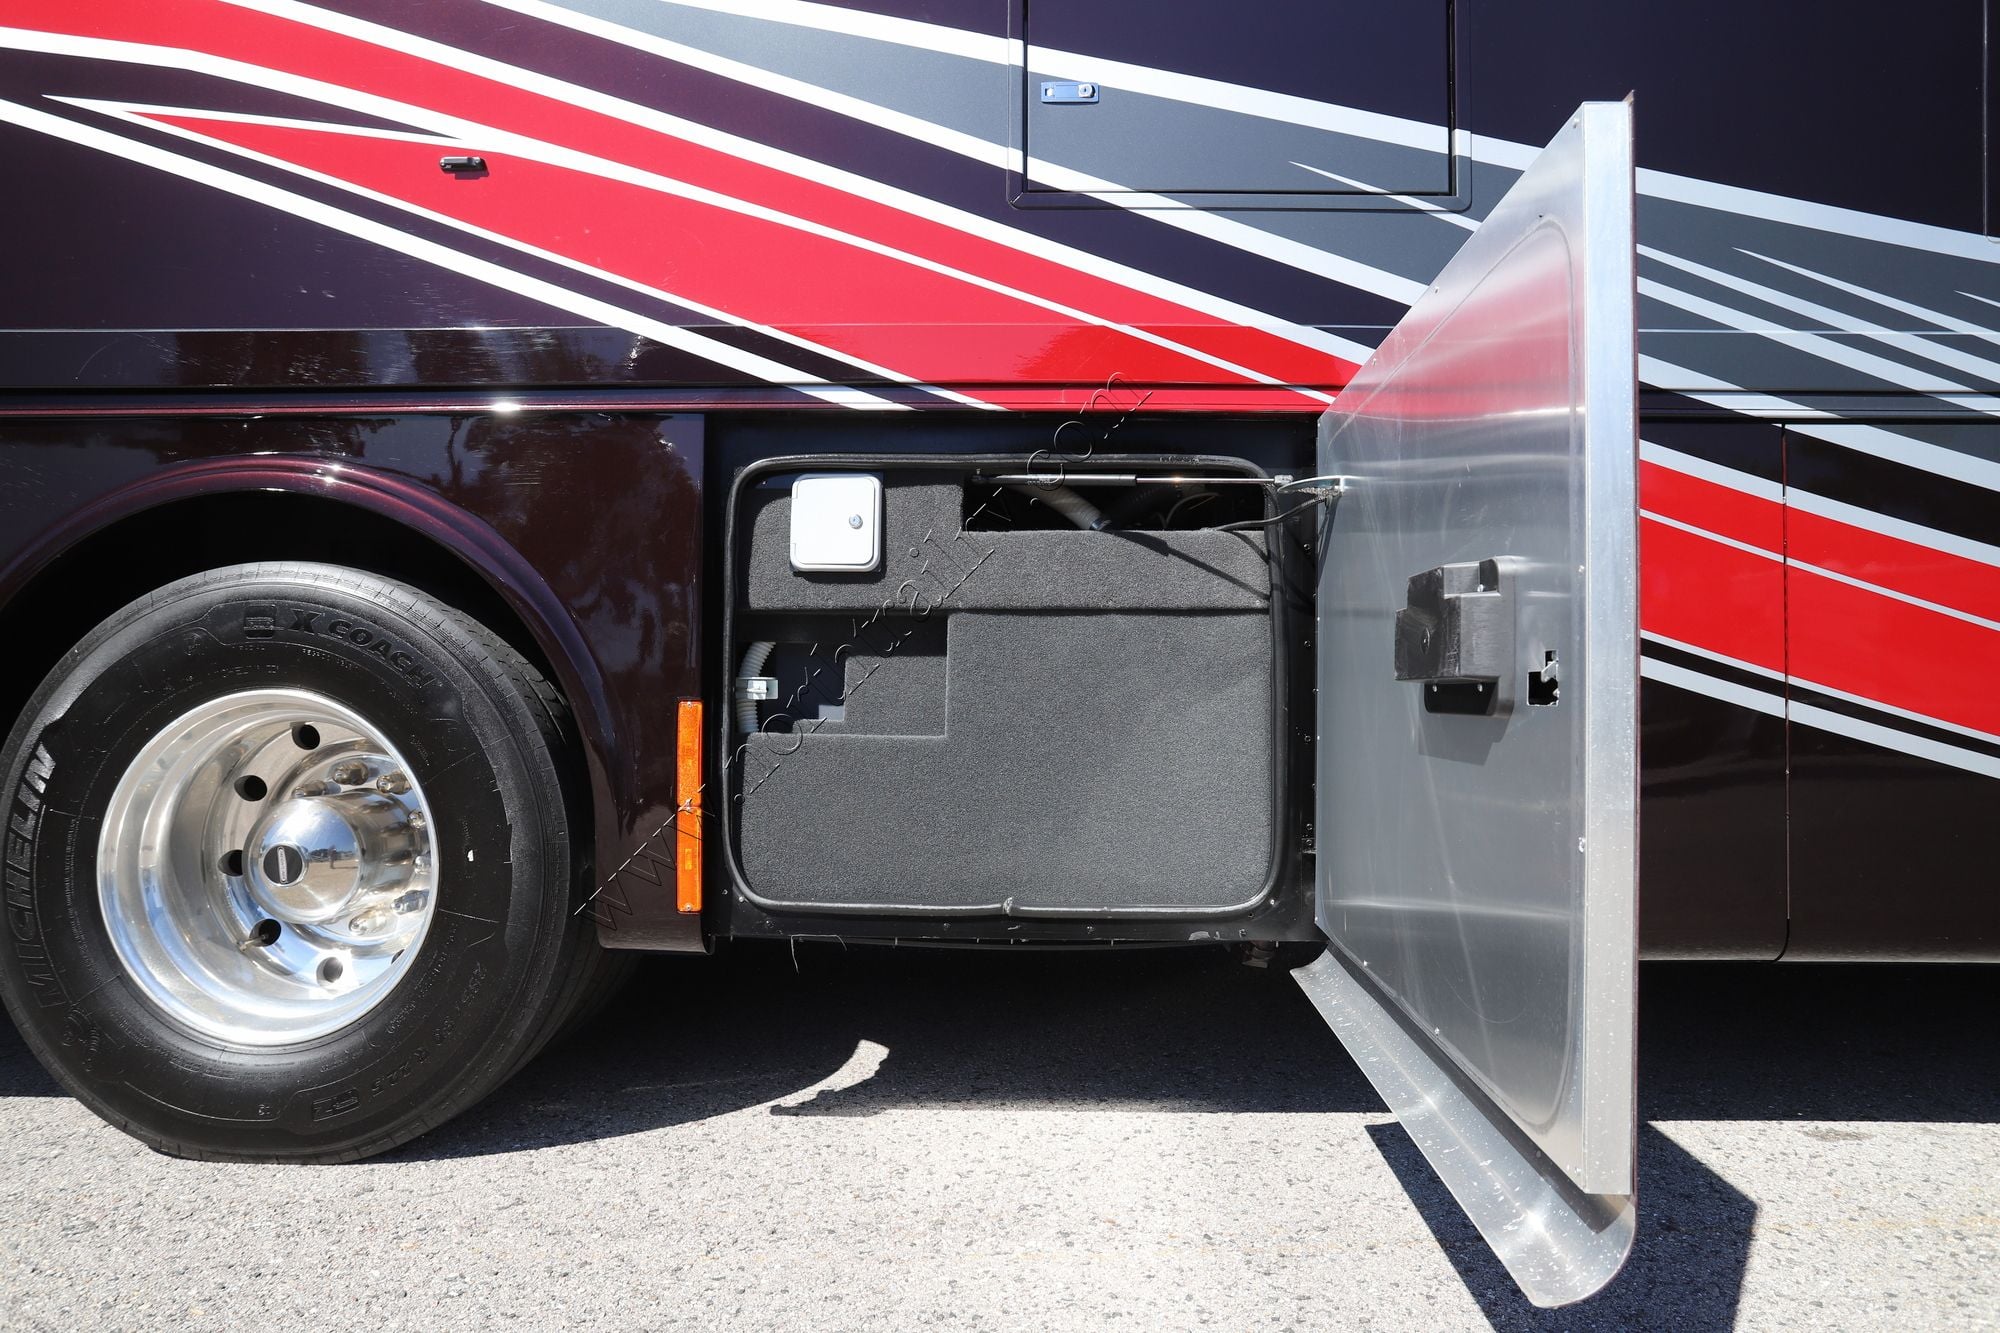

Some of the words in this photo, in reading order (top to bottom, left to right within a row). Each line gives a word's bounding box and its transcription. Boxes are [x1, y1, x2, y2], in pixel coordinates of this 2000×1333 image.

[290, 608, 325, 636] X
[327, 620, 436, 688] COACH
[6, 743, 64, 1009] MICHELIN
